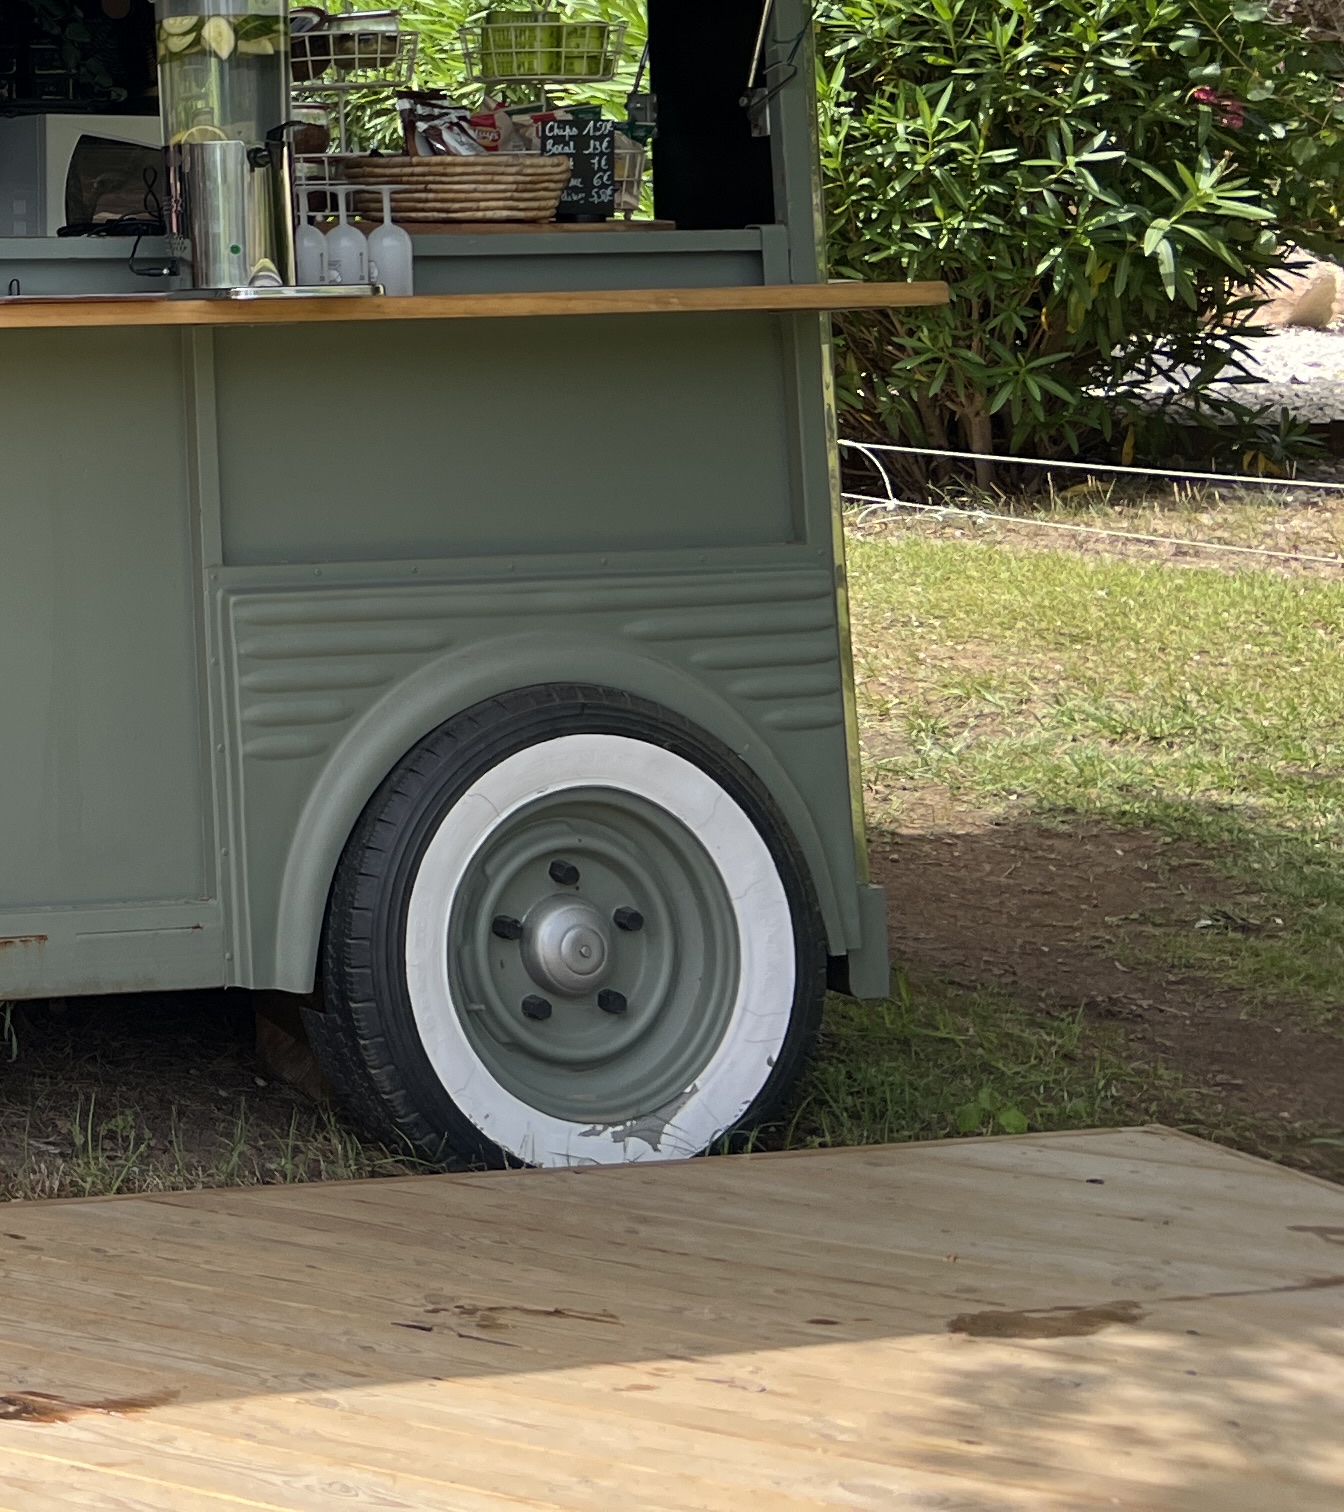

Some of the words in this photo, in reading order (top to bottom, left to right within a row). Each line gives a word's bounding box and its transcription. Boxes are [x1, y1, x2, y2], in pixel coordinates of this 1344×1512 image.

[544, 121, 579, 141] Chips
[582, 137, 612, 155] 13€
[593, 171, 613, 187] 6€
